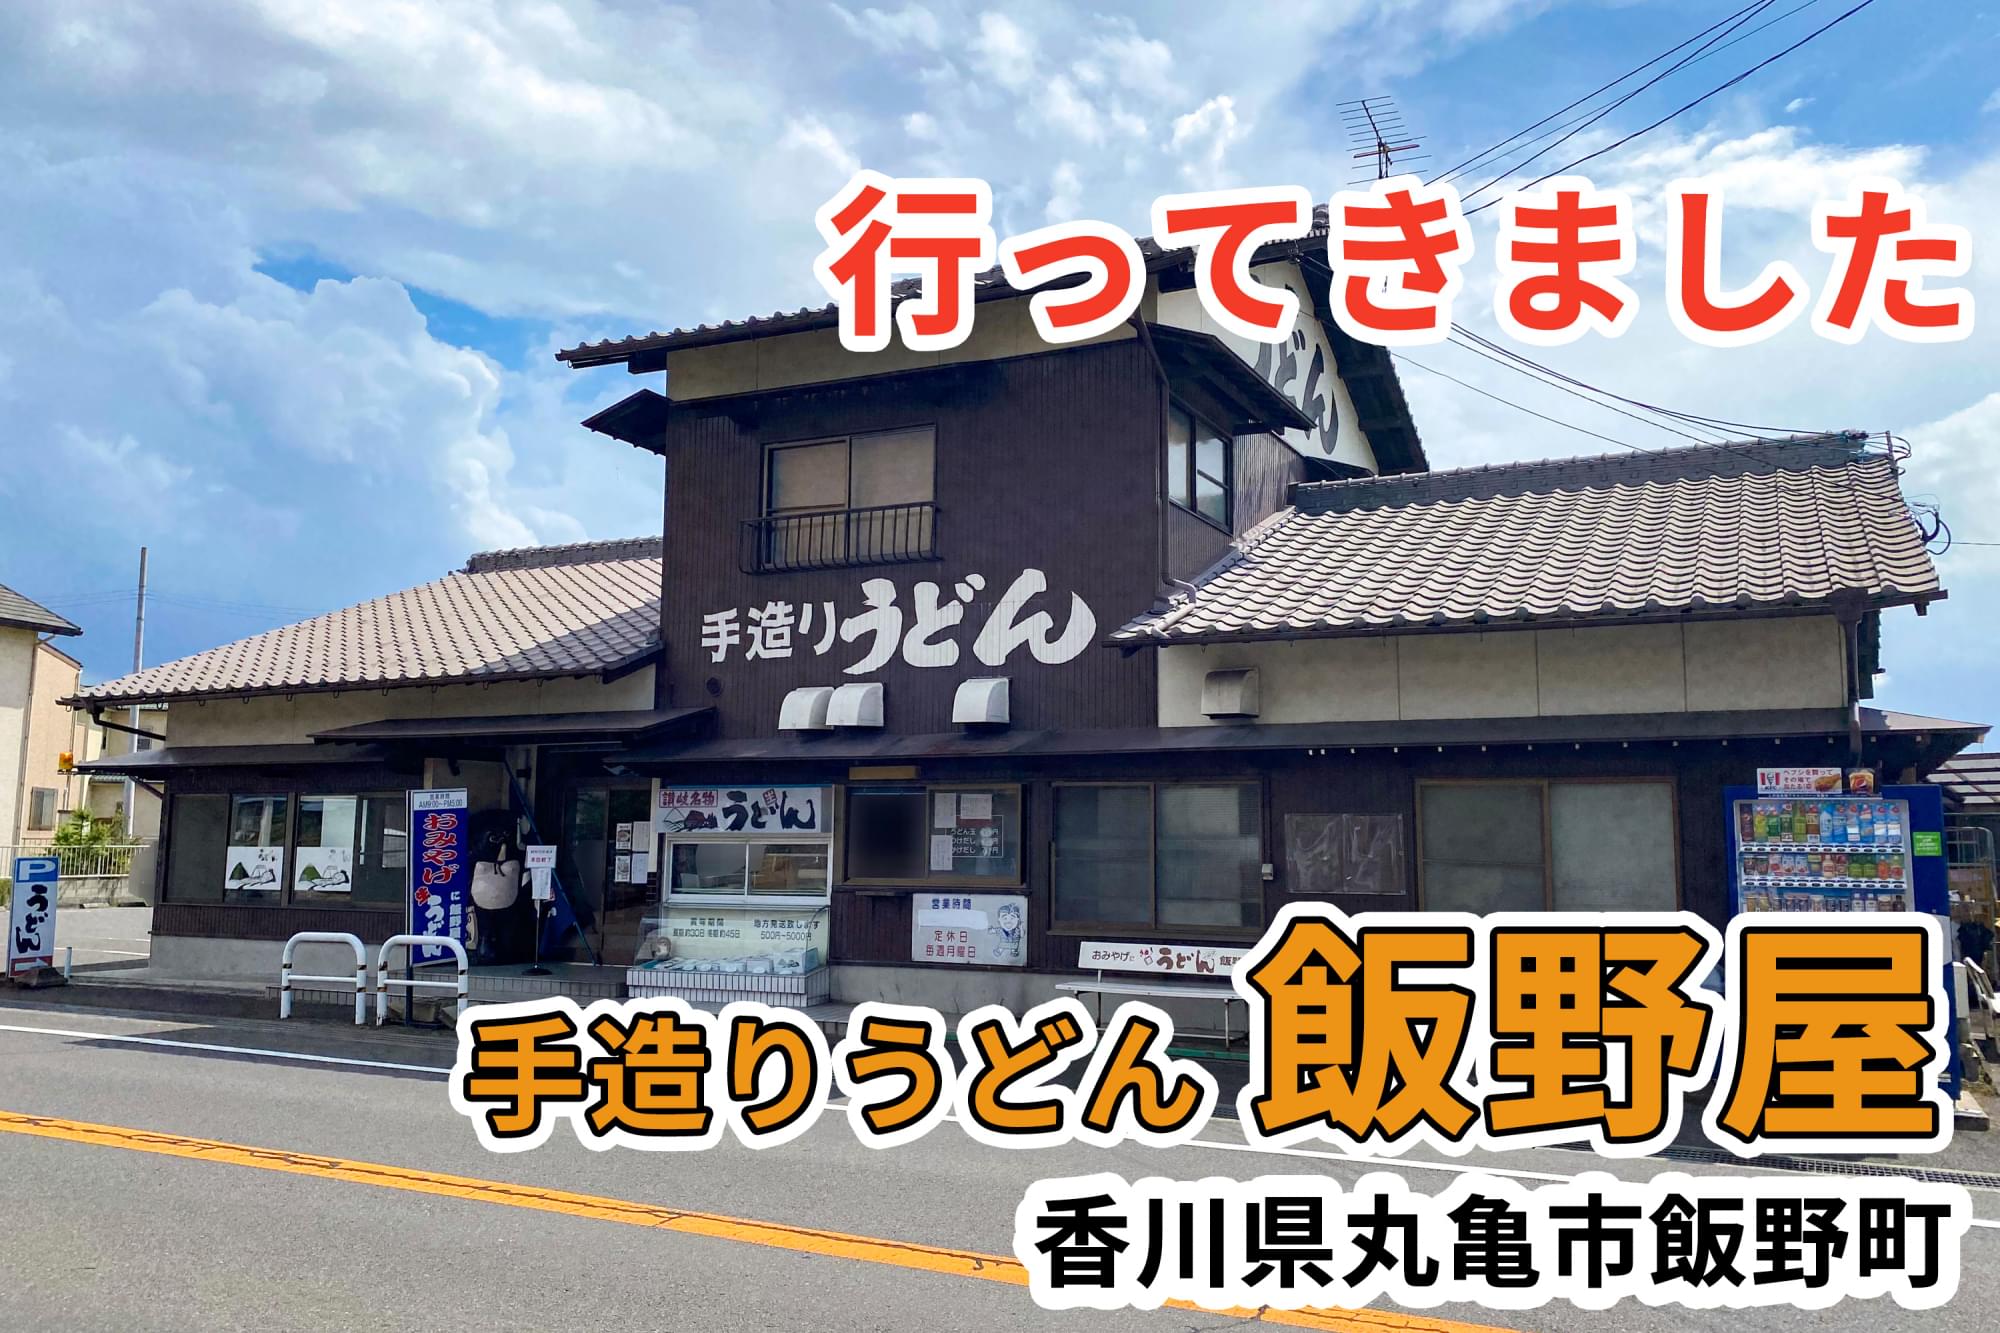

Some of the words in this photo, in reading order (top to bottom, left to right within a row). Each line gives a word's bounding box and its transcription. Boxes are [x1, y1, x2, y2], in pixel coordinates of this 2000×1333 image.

[701, 569, 1097, 675] 手造りうどん
[722, 791, 816, 831] うどん
[423, 813, 459, 884] おみやげ
[18, 860, 56, 881] P
[931, 898, 972, 910] 営業時間
[16, 884, 49, 953] うどん
[934, 931, 968, 942] 定休日
[926, 945, 976, 958] 毎週月曜日
[1156, 947, 1215, 974] うどん
